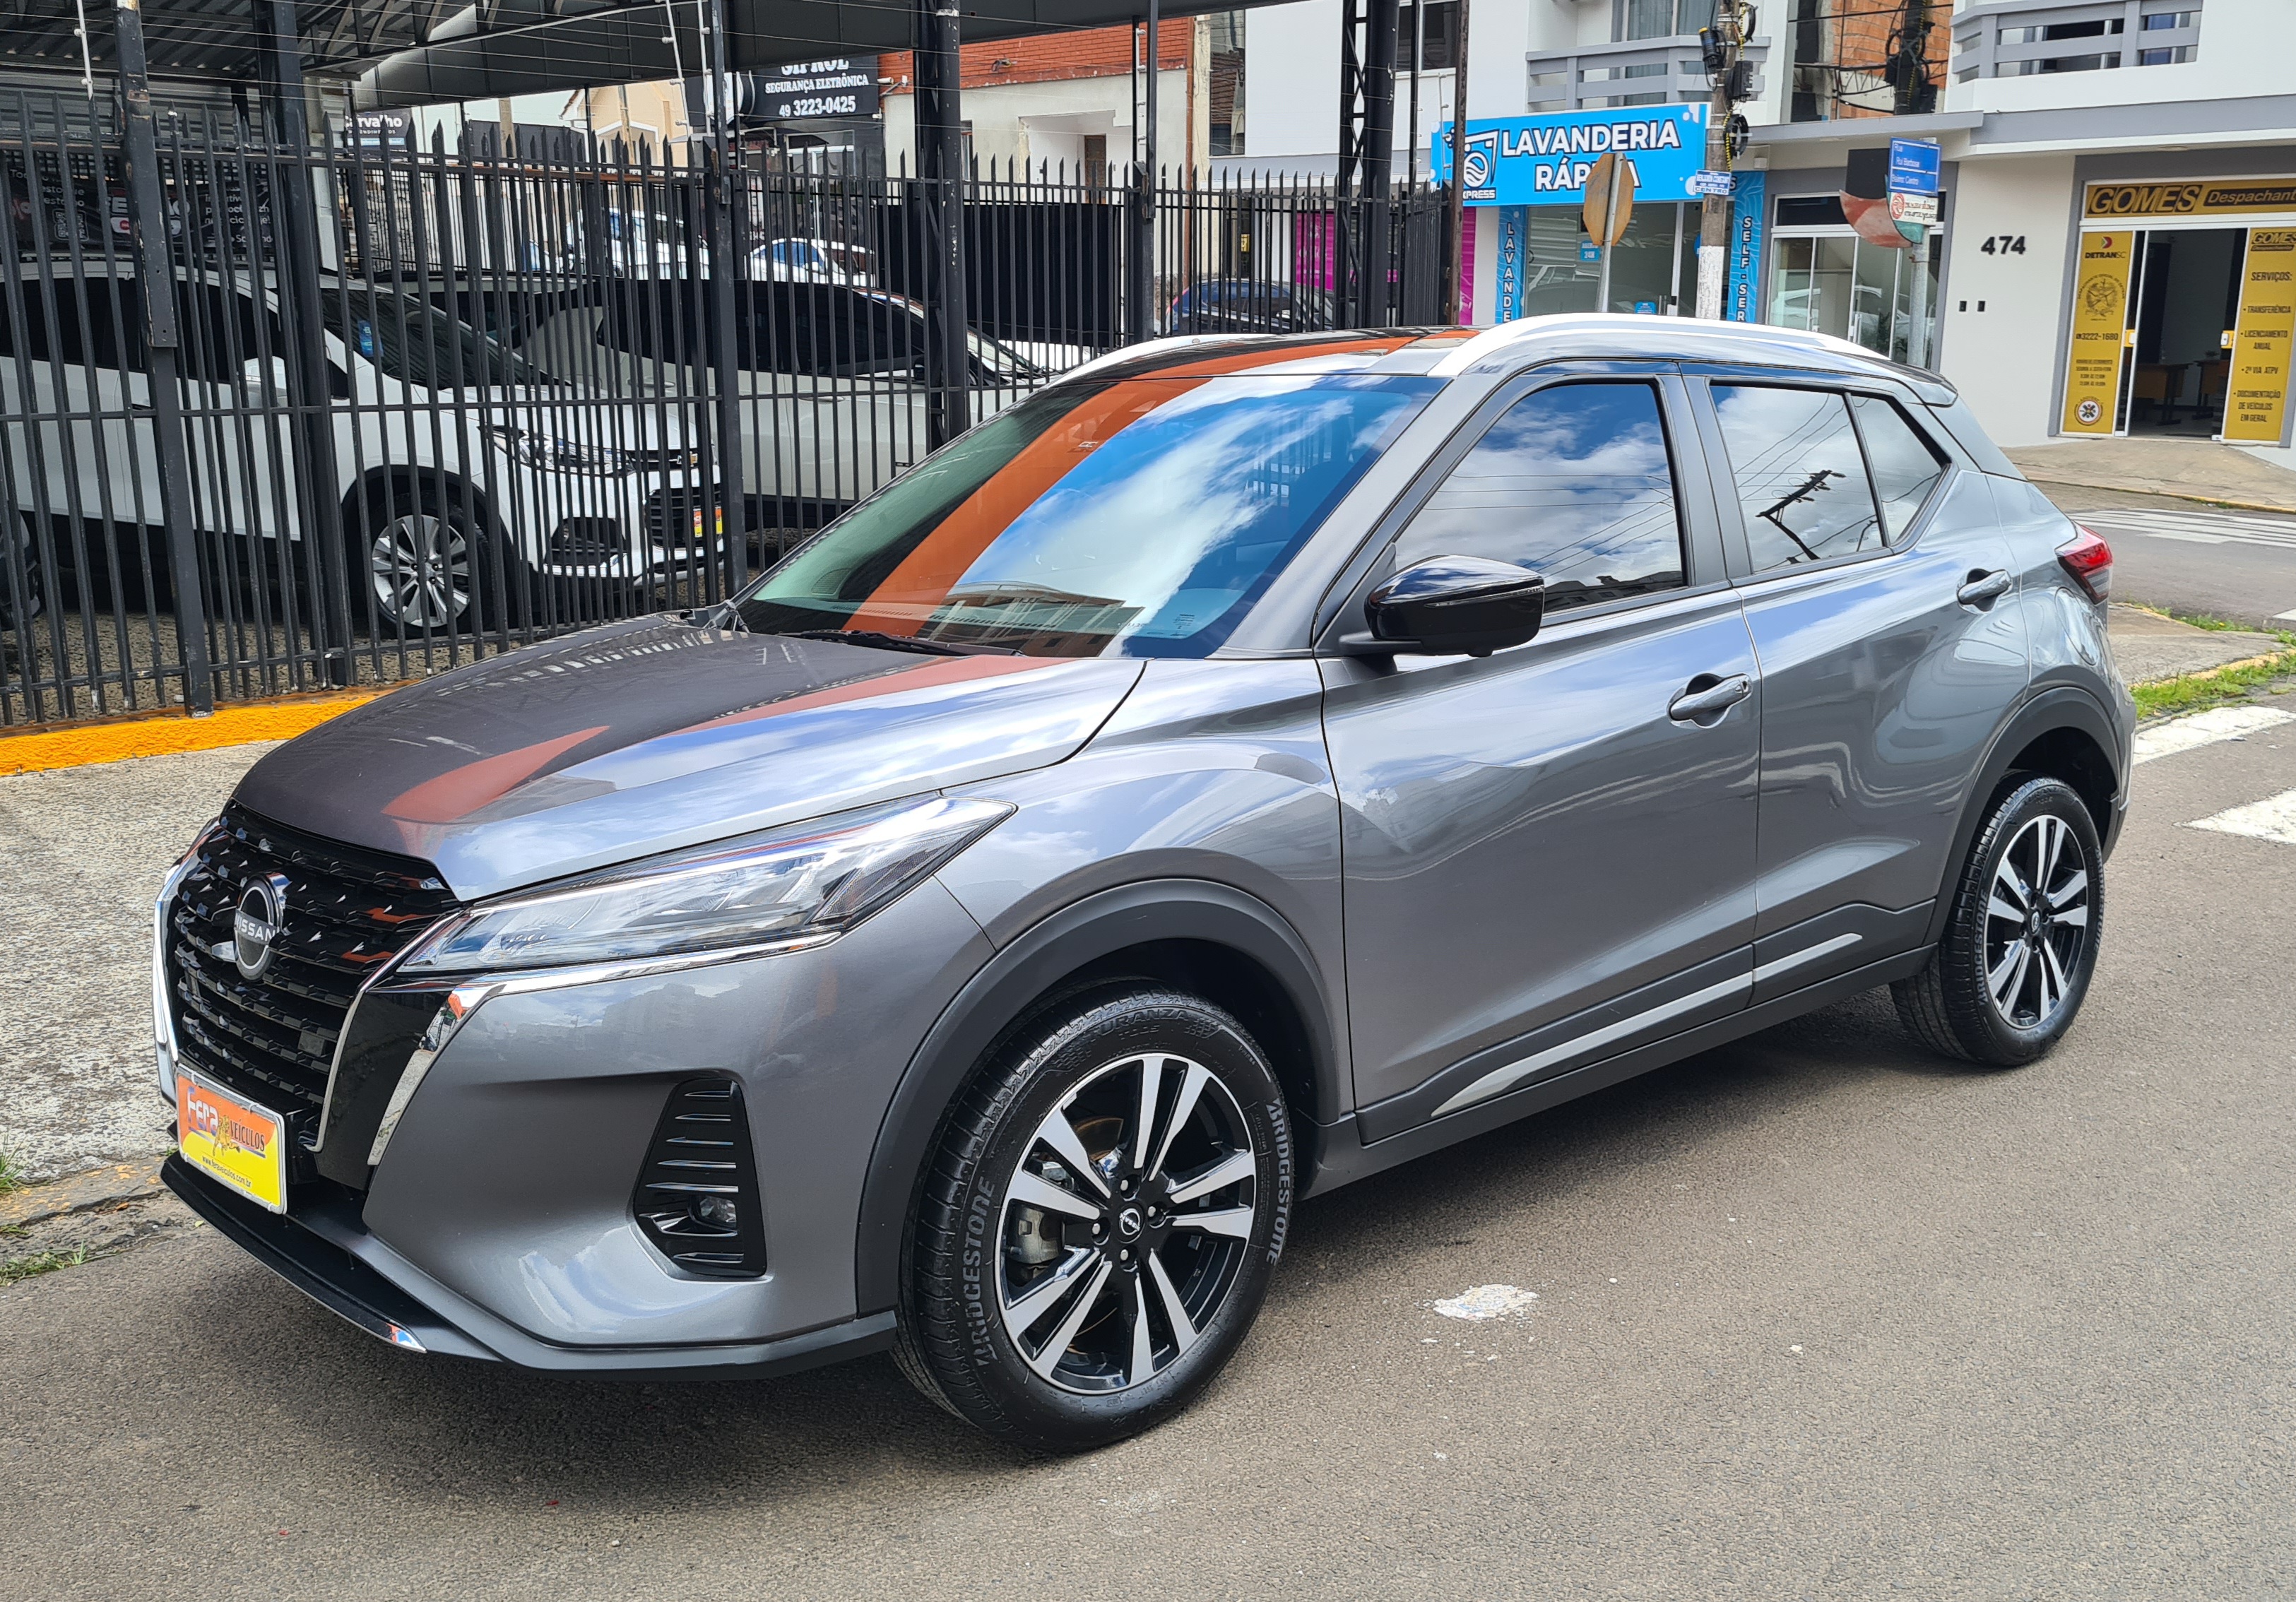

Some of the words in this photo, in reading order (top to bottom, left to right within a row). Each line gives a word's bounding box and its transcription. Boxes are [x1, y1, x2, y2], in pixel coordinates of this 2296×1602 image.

[765, 78, 815, 93] SEGURANÇA
[815, 72, 869, 90] ELETRÔNICA
[779, 105, 791, 117] 49
[793, 95, 856, 117] 3223-0425
[1501, 119, 1682, 158] LAVANDERIA
[1534, 155, 1642, 192] RÁP
[1462, 189, 1496, 200] XPRESS
[2088, 184, 2201, 213] GOMES
[1980, 235, 2026, 255] 474
[235, 915, 276, 942] NISSAN
[230, 1118, 266, 1152] VEÍCULOS
[1266, 1098, 1291, 1266] BRIDGESTONE
[962, 1175, 998, 1367] BRIDGESTONE
